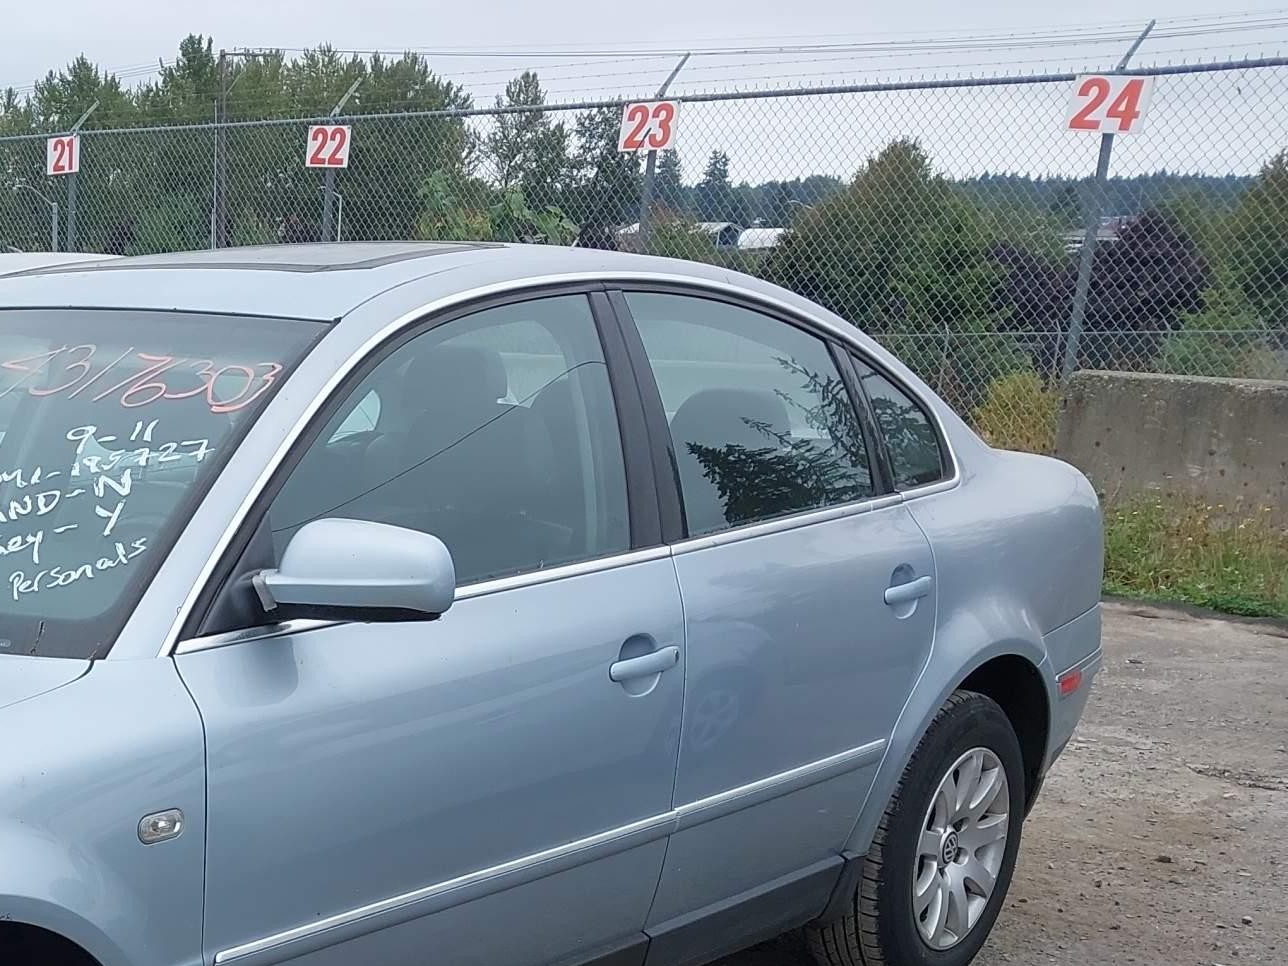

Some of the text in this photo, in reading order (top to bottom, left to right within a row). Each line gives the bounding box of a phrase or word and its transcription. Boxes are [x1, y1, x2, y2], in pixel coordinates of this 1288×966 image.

[622, 101, 675, 150] 23
[1069, 77, 1144, 132] 24
[52, 138, 74, 172] 21
[309, 127, 347, 166] 22
[9, 537, 148, 601] Personals
